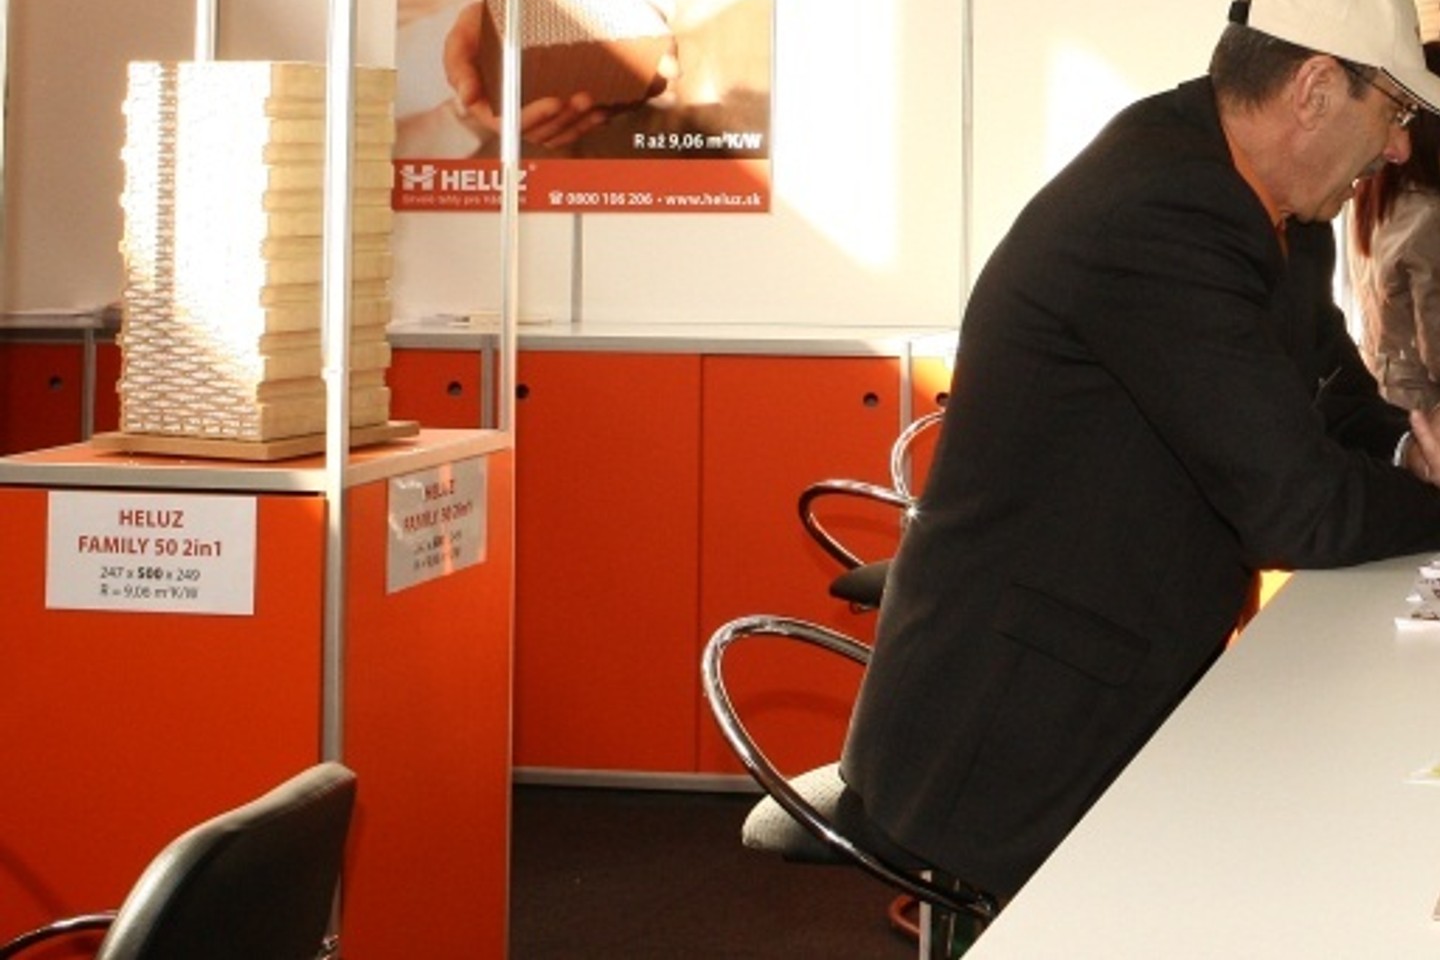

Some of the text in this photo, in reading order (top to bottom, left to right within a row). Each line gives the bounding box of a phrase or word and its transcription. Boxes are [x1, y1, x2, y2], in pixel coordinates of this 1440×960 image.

[633, 133, 645, 149] R
[647, 133, 665, 149] až
[669, 133, 703, 150] 9,06
[566, 192, 600, 205] 0800
[627, 192, 653, 205] 206
[665, 192, 761, 206] www.heluz.sk
[119, 510, 184, 528] HELUZ
[78, 536, 222, 557] FAMILY 50 2in1
[100, 566, 124, 579] 247
[137, 566, 163, 580] 500
